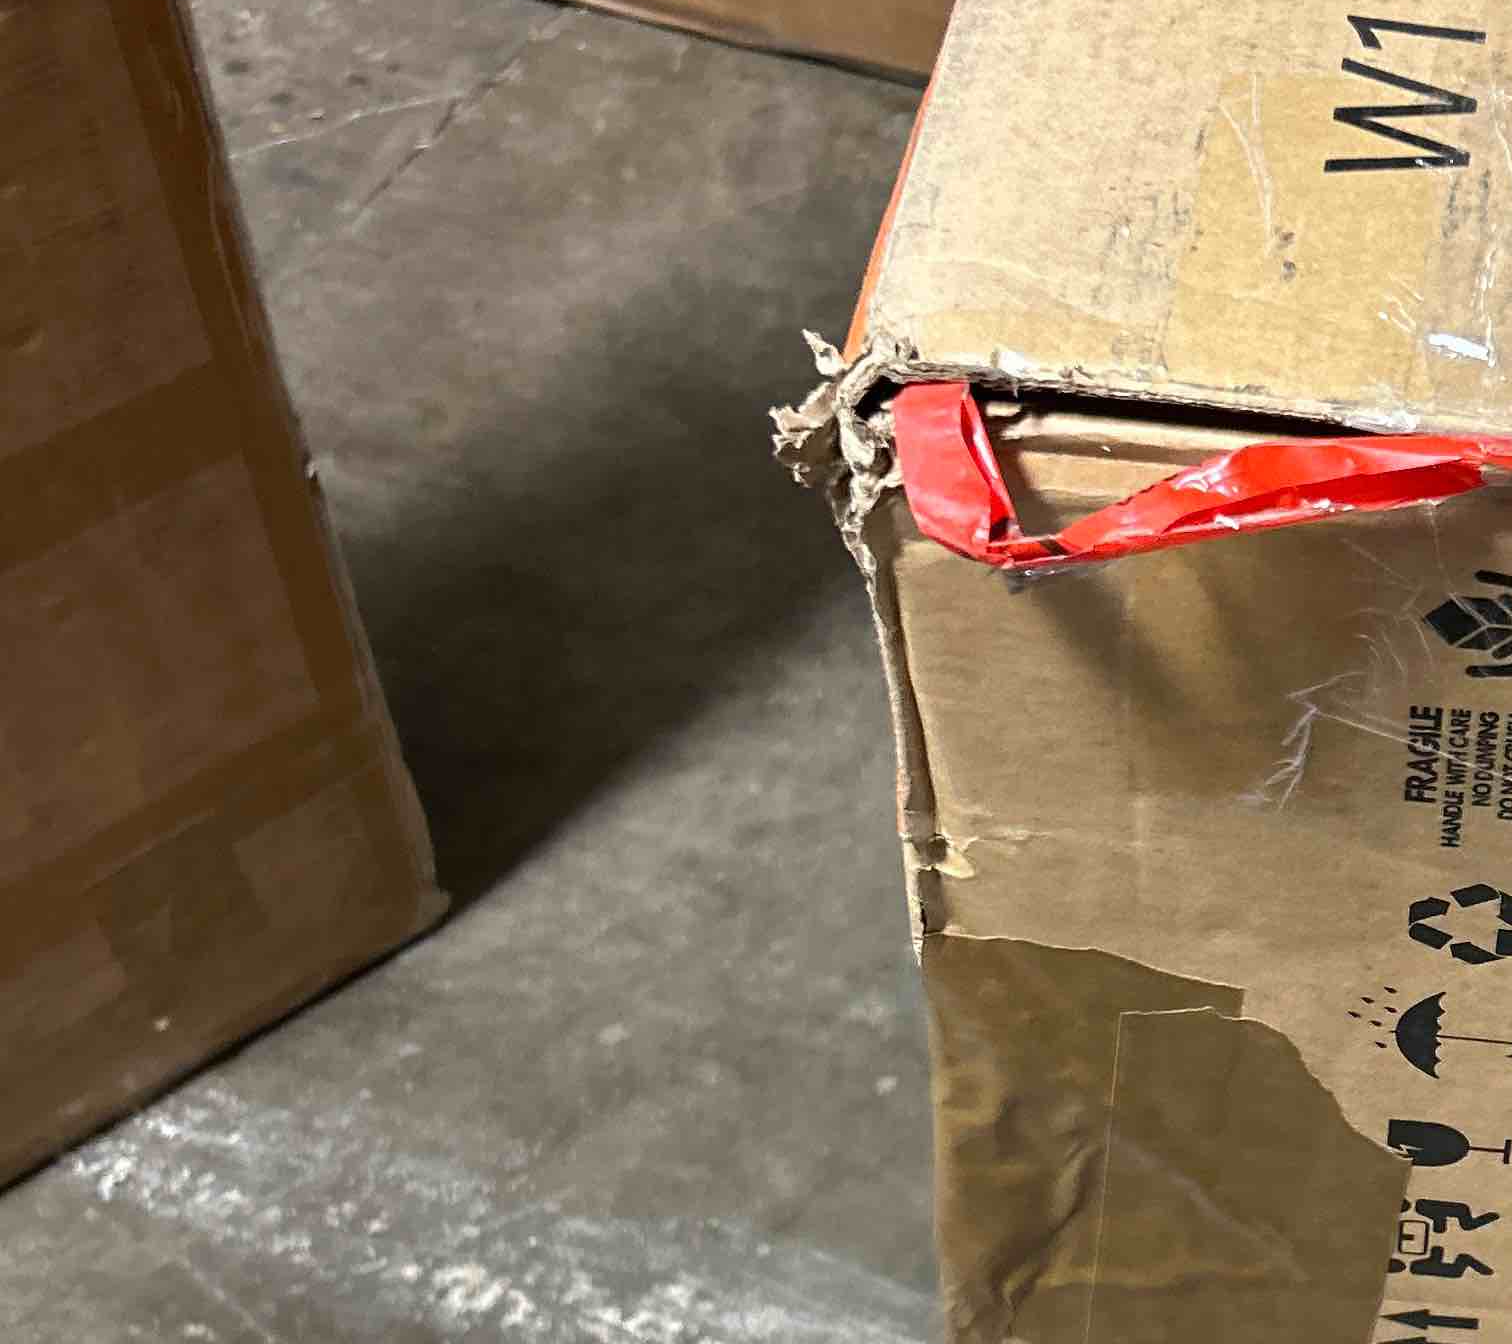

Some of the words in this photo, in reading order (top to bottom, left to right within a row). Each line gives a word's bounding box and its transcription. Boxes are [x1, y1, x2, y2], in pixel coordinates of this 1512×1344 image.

[1449, 709, 1471, 748] CARE
[1475, 712, 1499, 781] DUMPING
[1404, 706, 1443, 803] FRAGILE
[1445, 751, 1468, 785] WITH
[1441, 791, 1464, 847] HANDLE
[1473, 786, 1491, 806] NO
